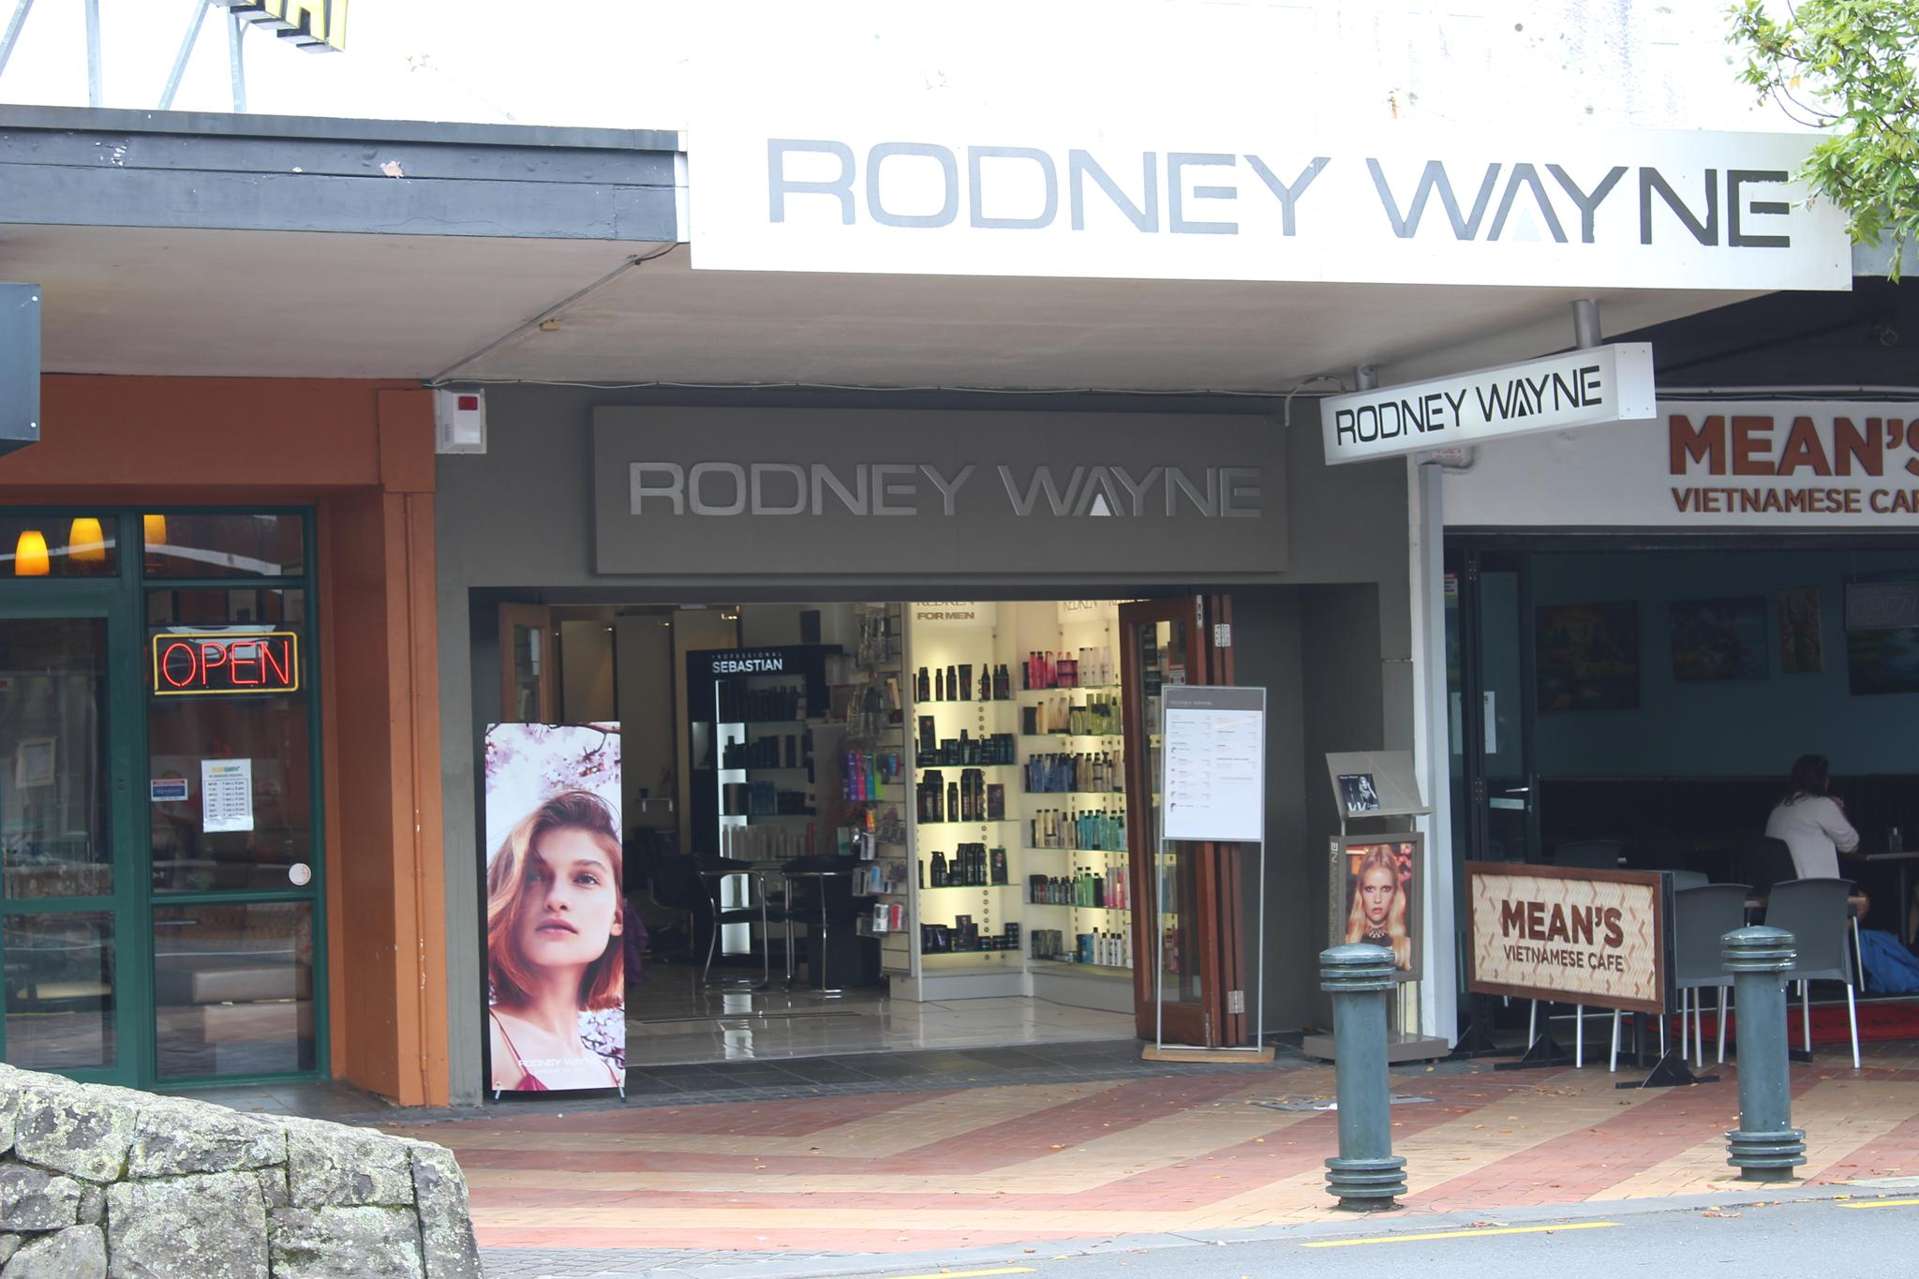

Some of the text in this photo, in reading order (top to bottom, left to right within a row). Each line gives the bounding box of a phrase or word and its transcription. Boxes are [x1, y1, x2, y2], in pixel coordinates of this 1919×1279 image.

[768, 138, 1790, 248] RODNEY WAYNE
[1335, 365, 1603, 446] RODNEY WAYNE
[628, 462, 1262, 518] RODNEY WAYNE
[1671, 487, 1863, 514] VIETNAMESE
[917, 611, 976, 621] FOR MEN
[162, 640, 289, 687] OPEN
[712, 658, 783, 674] SEBASTIAN
[1501, 899, 1625, 949] MEAN'S
[1503, 944, 1625, 973] VIETNAMESE CAFE
